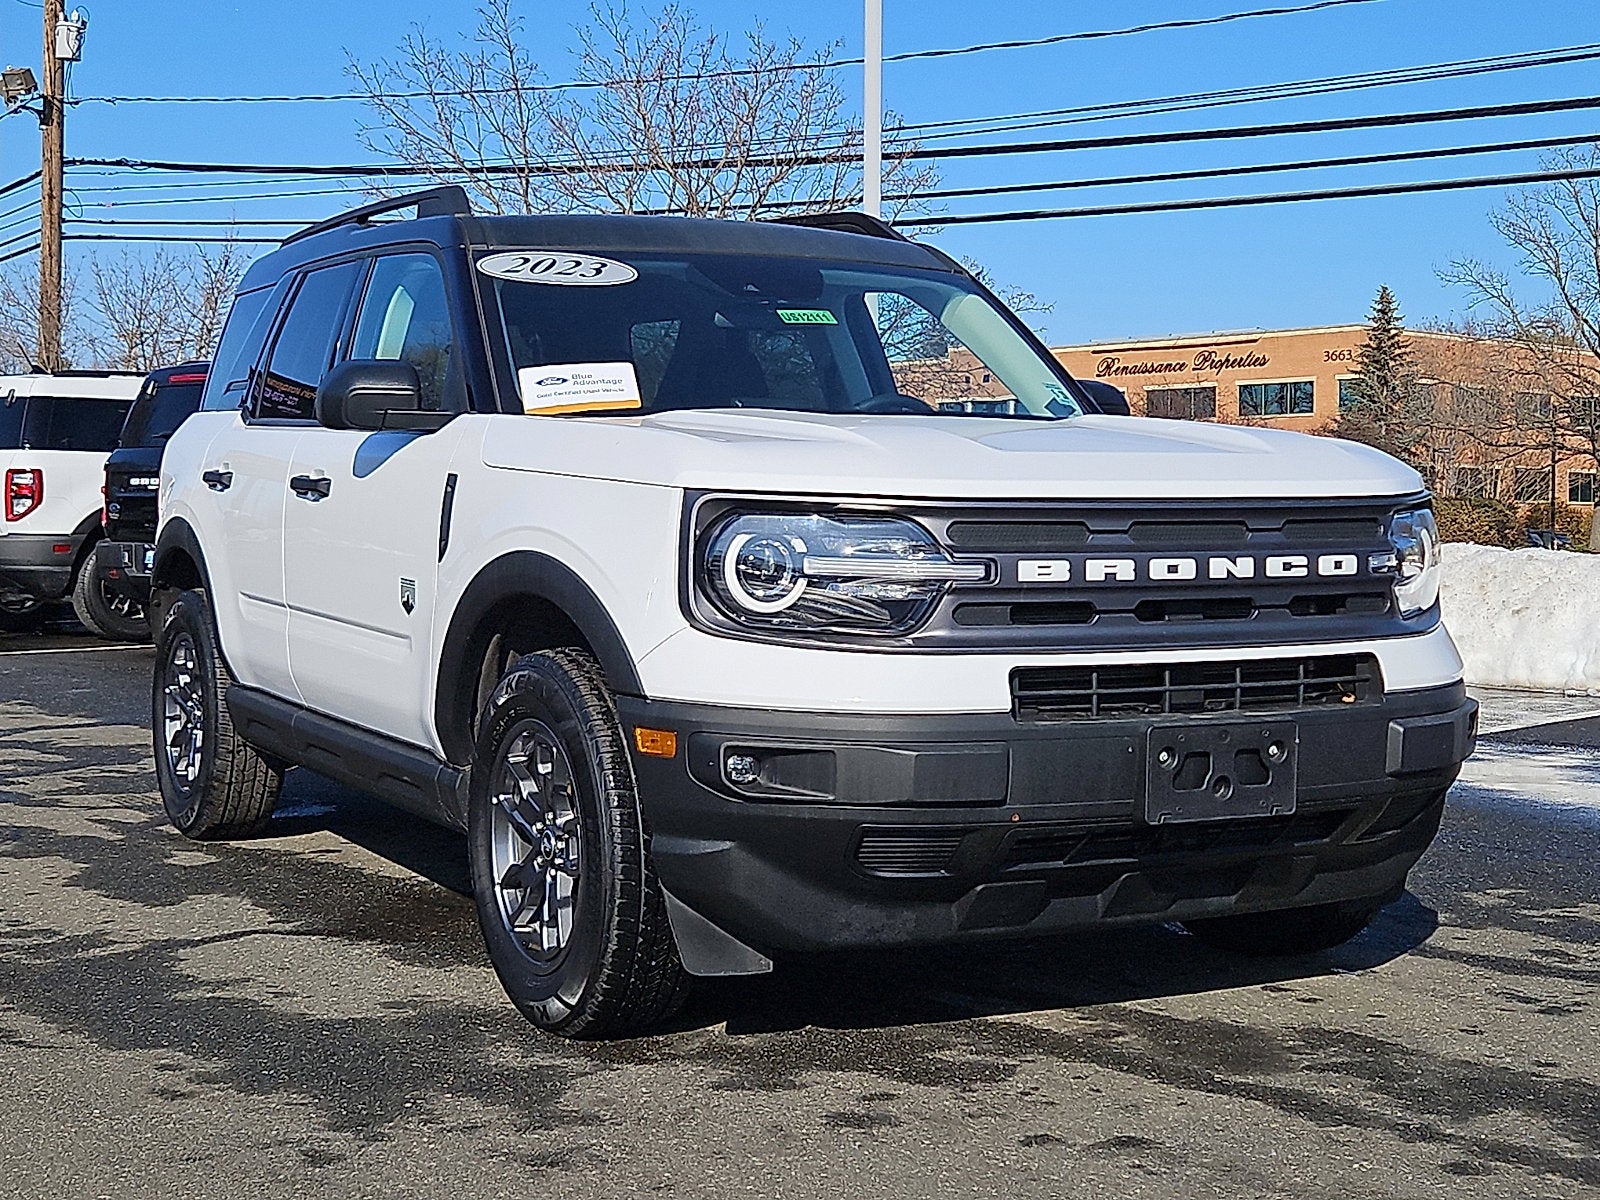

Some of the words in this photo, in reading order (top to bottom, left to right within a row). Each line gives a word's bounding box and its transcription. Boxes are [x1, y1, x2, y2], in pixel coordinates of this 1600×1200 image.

[505, 256, 609, 280] 2023
[781, 311, 830, 322] US12111
[1095, 357, 1189, 379] Renaissance
[1192, 350, 1271, 376] Properties
[1322, 349, 1353, 363] 3663
[572, 379, 624, 387] Advantage
[1016, 554, 1358, 583] BRONCO
